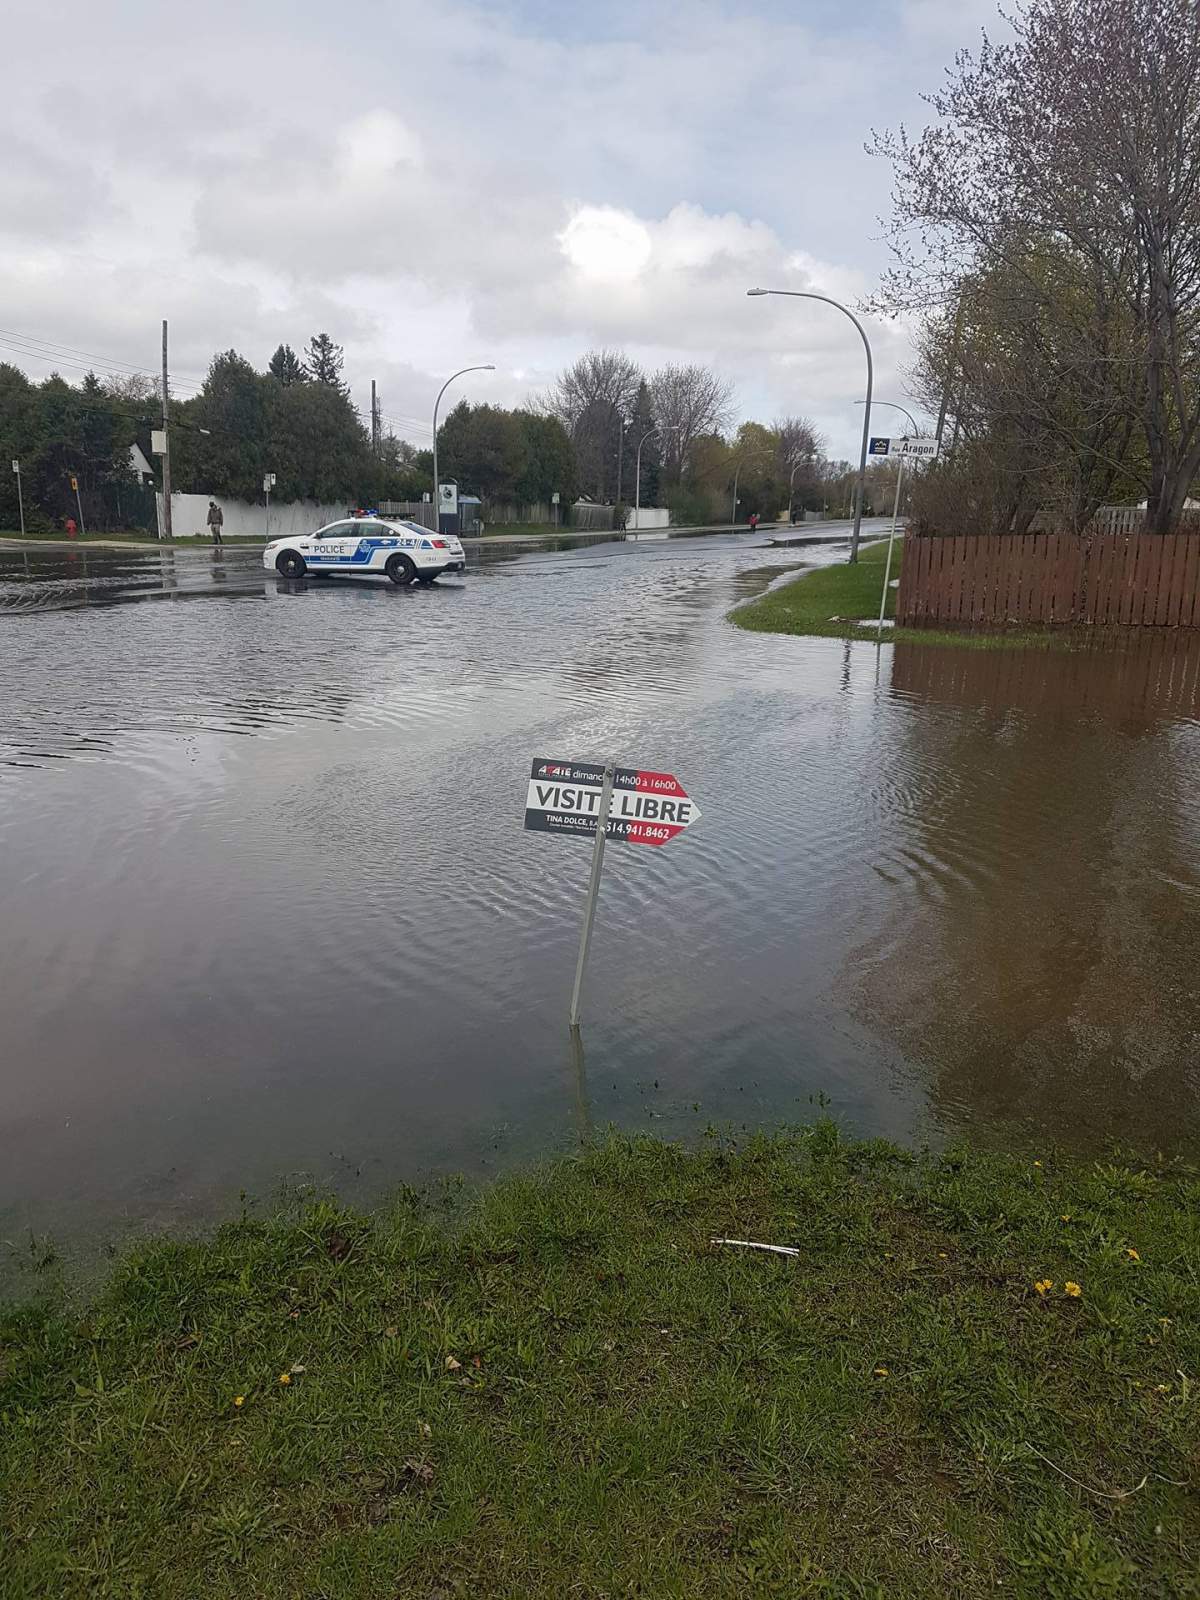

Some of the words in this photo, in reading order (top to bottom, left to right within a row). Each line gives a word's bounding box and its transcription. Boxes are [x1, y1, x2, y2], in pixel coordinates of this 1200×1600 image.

[902, 443, 934, 455] Aragon
[314, 545, 345, 554] POLICE
[572, 769, 604, 781] dimanc
[615, 774, 641, 785] 14h00
[642, 778, 648, 787] à
[651, 779, 676, 790] 16h00
[621, 795, 691, 823] LIBRE
[546, 815, 563, 823] TINA
[564, 817, 588, 827] DOLCE,
[606, 821, 670, 839] 514.941.8462
